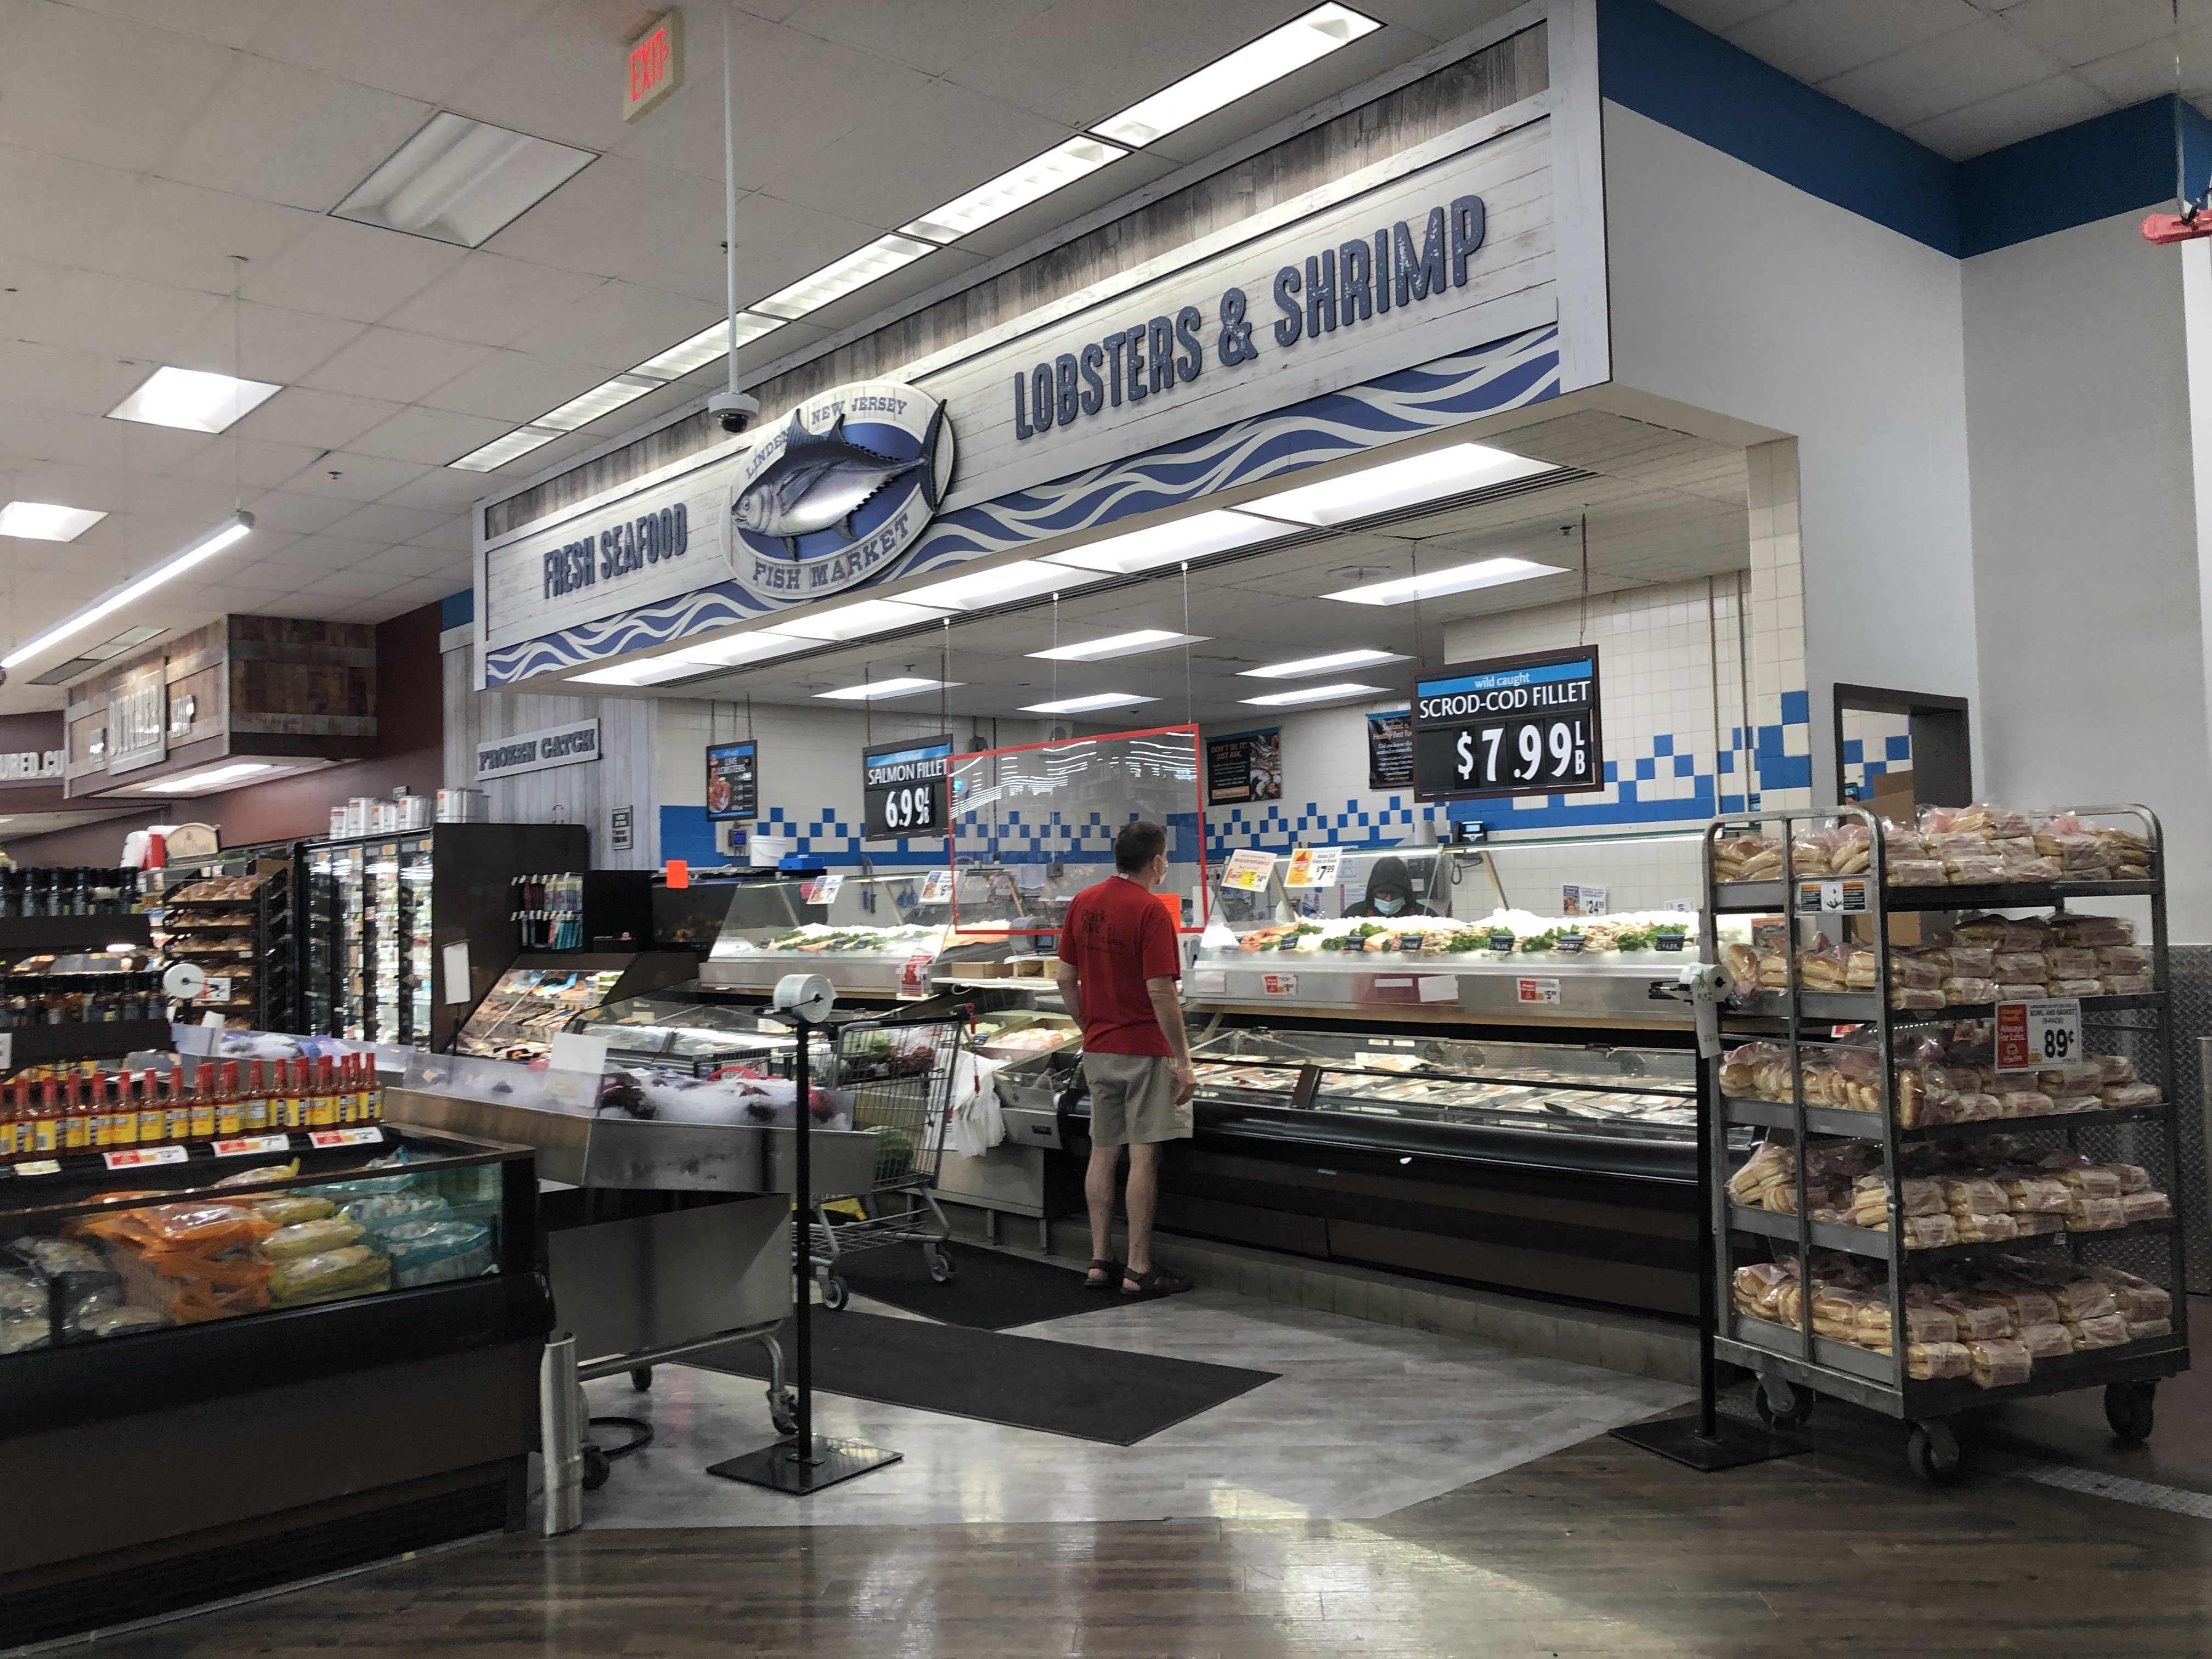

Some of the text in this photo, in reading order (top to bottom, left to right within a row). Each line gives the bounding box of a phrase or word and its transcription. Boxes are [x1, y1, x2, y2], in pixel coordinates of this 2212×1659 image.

[630, 28, 665, 101] EXIT
[1014, 194, 1486, 441] LOBSTERS & SHRIMP
[746, 396, 907, 479] LINDEN NEW JERSEY
[543, 503, 687, 599] FRESH SEAFOOD
[753, 512, 909, 590] FISH MARKET
[1419, 680, 1591, 719] SCROD-COD FILLET
[1474, 672, 1530, 689] wild caught
[479, 729, 595, 771] FROZEN CATCH
[868, 759, 947, 786] SALMON FILLET
[1457, 722, 1573, 782] $7.99
[885, 787, 926, 828] 6.99
